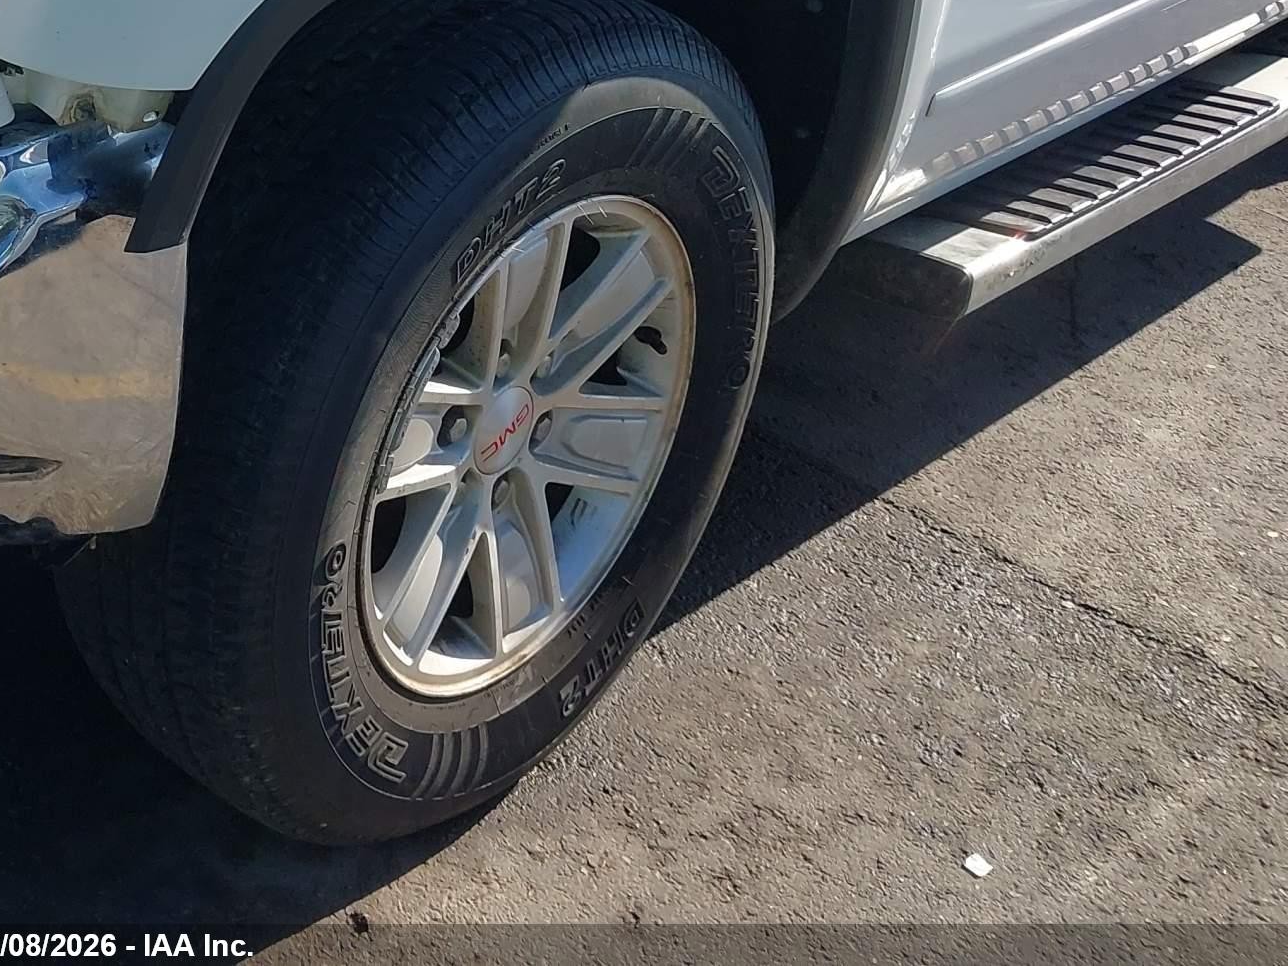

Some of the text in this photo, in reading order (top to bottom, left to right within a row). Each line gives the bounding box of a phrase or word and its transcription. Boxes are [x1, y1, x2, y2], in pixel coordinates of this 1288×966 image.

[456, 158, 566, 284] DHT2
[480, 403, 530, 463] GMC
[320, 540, 409, 784] DEXTERO
